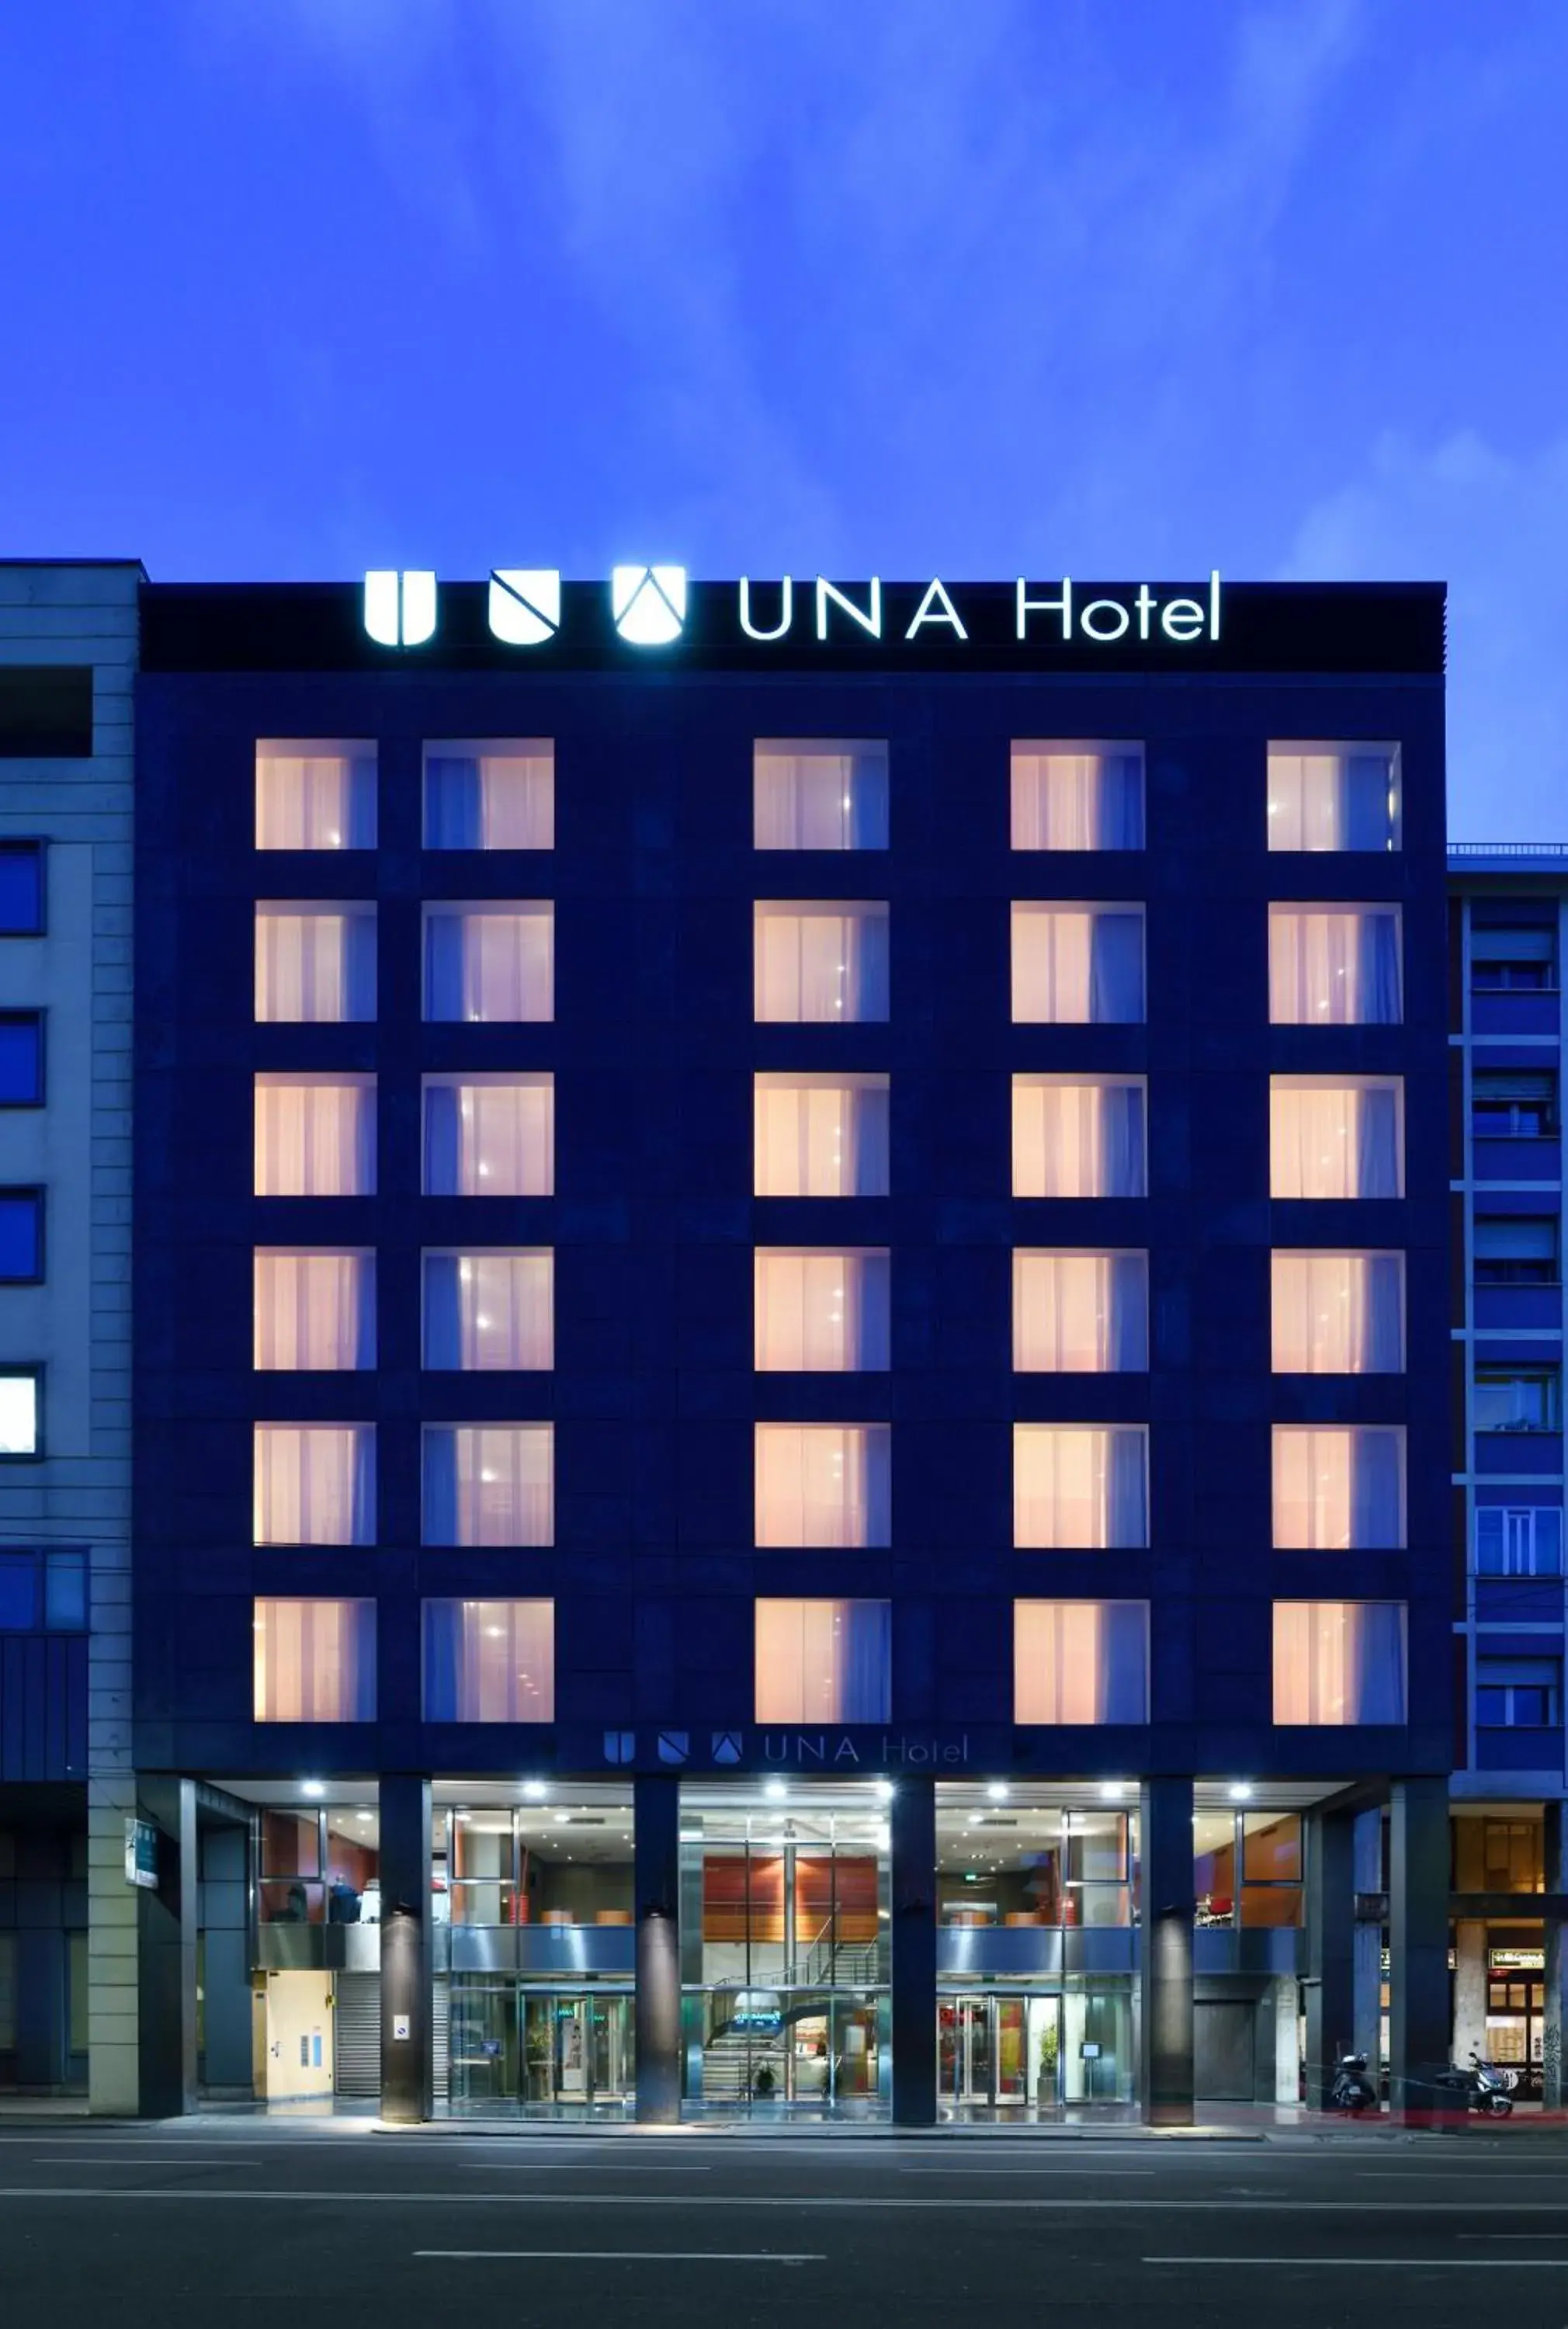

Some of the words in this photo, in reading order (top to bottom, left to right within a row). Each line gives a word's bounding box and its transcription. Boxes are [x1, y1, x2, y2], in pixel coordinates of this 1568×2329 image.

[740, 574, 969, 640] UNA
[1016, 570, 1219, 640] Hotel
[765, 1734, 859, 1763] UNA
[883, 1734, 968, 1763] Hotel
